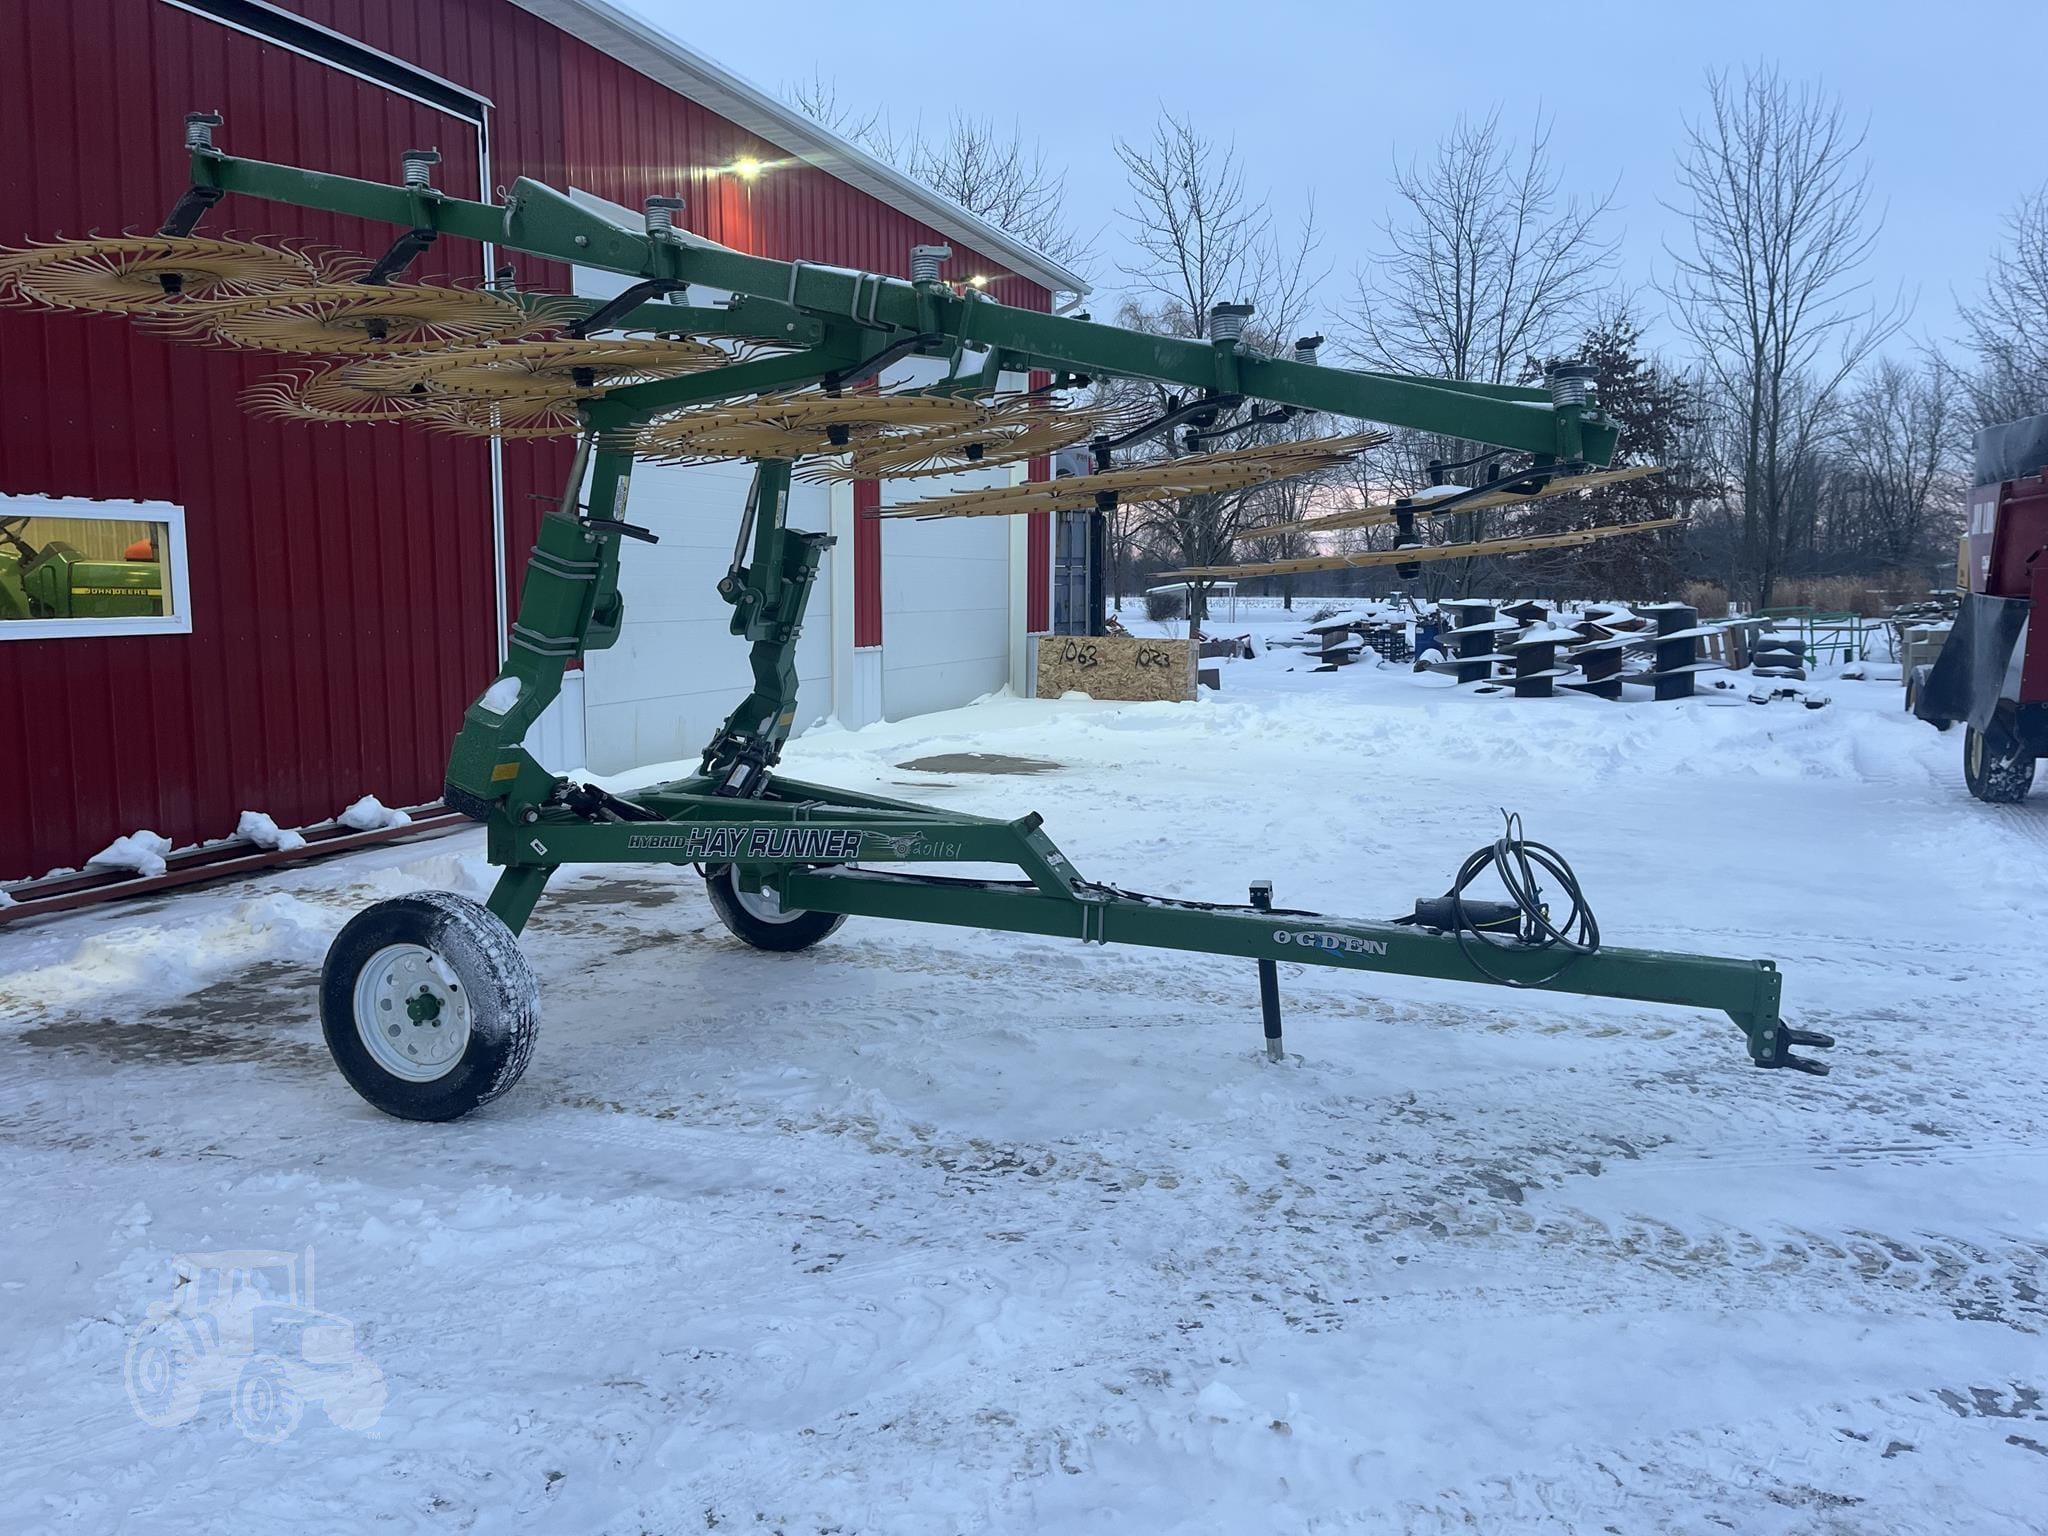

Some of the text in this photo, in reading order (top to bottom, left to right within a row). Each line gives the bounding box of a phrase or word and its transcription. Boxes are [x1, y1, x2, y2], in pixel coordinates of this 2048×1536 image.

[86, 587, 147, 597] JOHN DEERE
[1059, 639, 1098, 669] 1063
[628, 827, 863, 858] HYBRID HAY RUNNER
[1272, 930, 1389, 956] OGDEN
